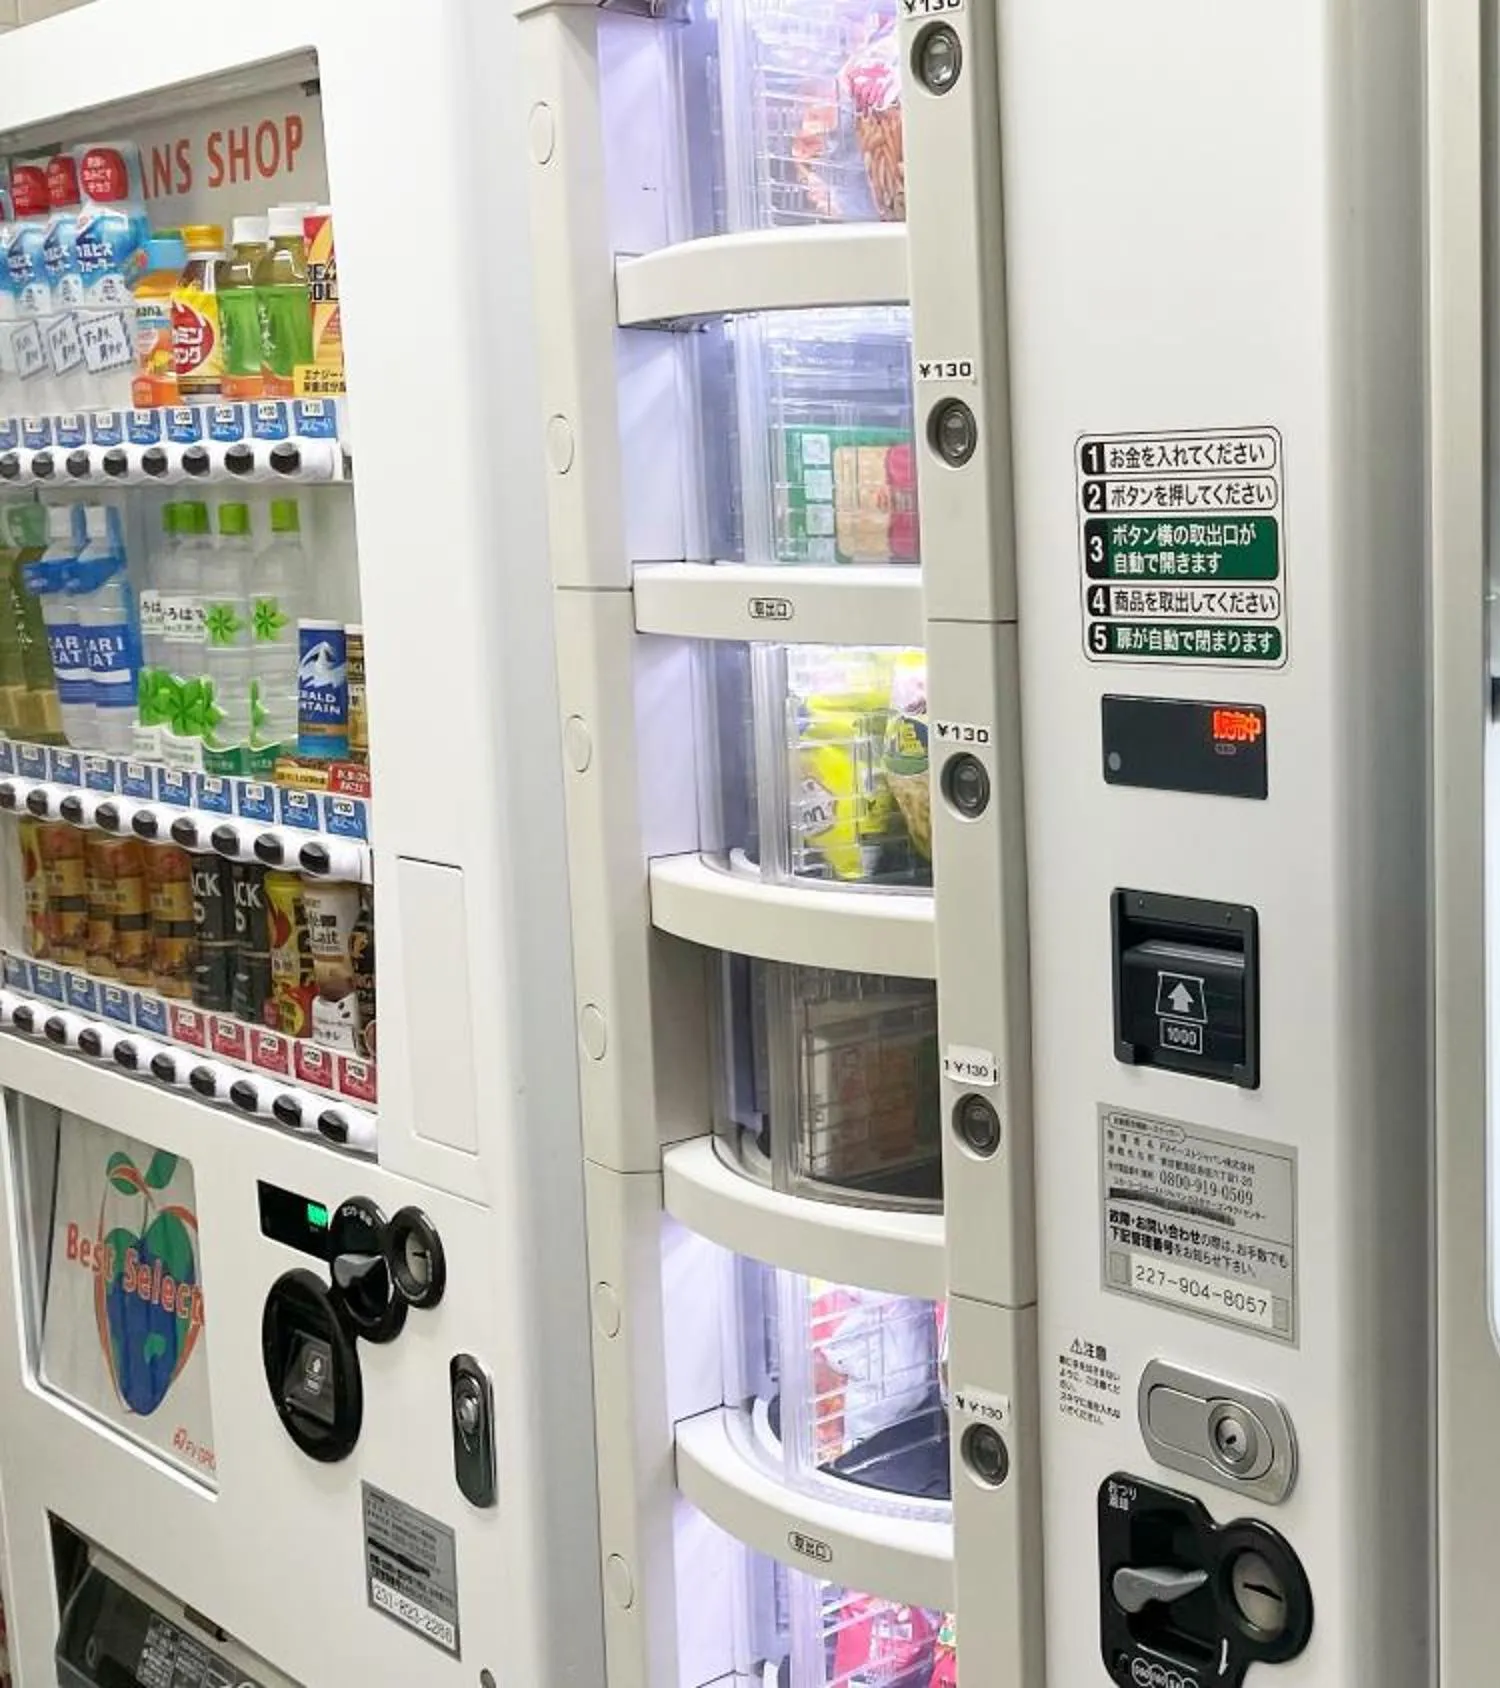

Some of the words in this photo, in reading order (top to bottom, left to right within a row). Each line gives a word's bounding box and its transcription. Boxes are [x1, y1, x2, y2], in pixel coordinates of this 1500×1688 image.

[207, 115, 303, 189] SHOP
[918, 362, 972, 378] ¥130
[1088, 445, 1099, 472] 1
[1109, 441, 1265, 470] お金を入れてください
[1088, 483, 1102, 510] 2
[1110, 482, 1273, 508] ボタンを押してください
[1090, 537, 1104, 563] 3
[1112, 522, 1257, 547] ボタン横の取出口が
[1113, 551, 1223, 575] 自動で開きます
[1092, 587, 1106, 614] 4
[1114, 590, 1277, 614] 商品を取出してください
[1094, 625, 1107, 651] 5
[1116, 627, 1274, 654] 扉が自動で閉まります
[936, 722, 989, 744] ¥130
[953, 1061, 989, 1079] ¥130
[66, 1222, 116, 1288] Best
